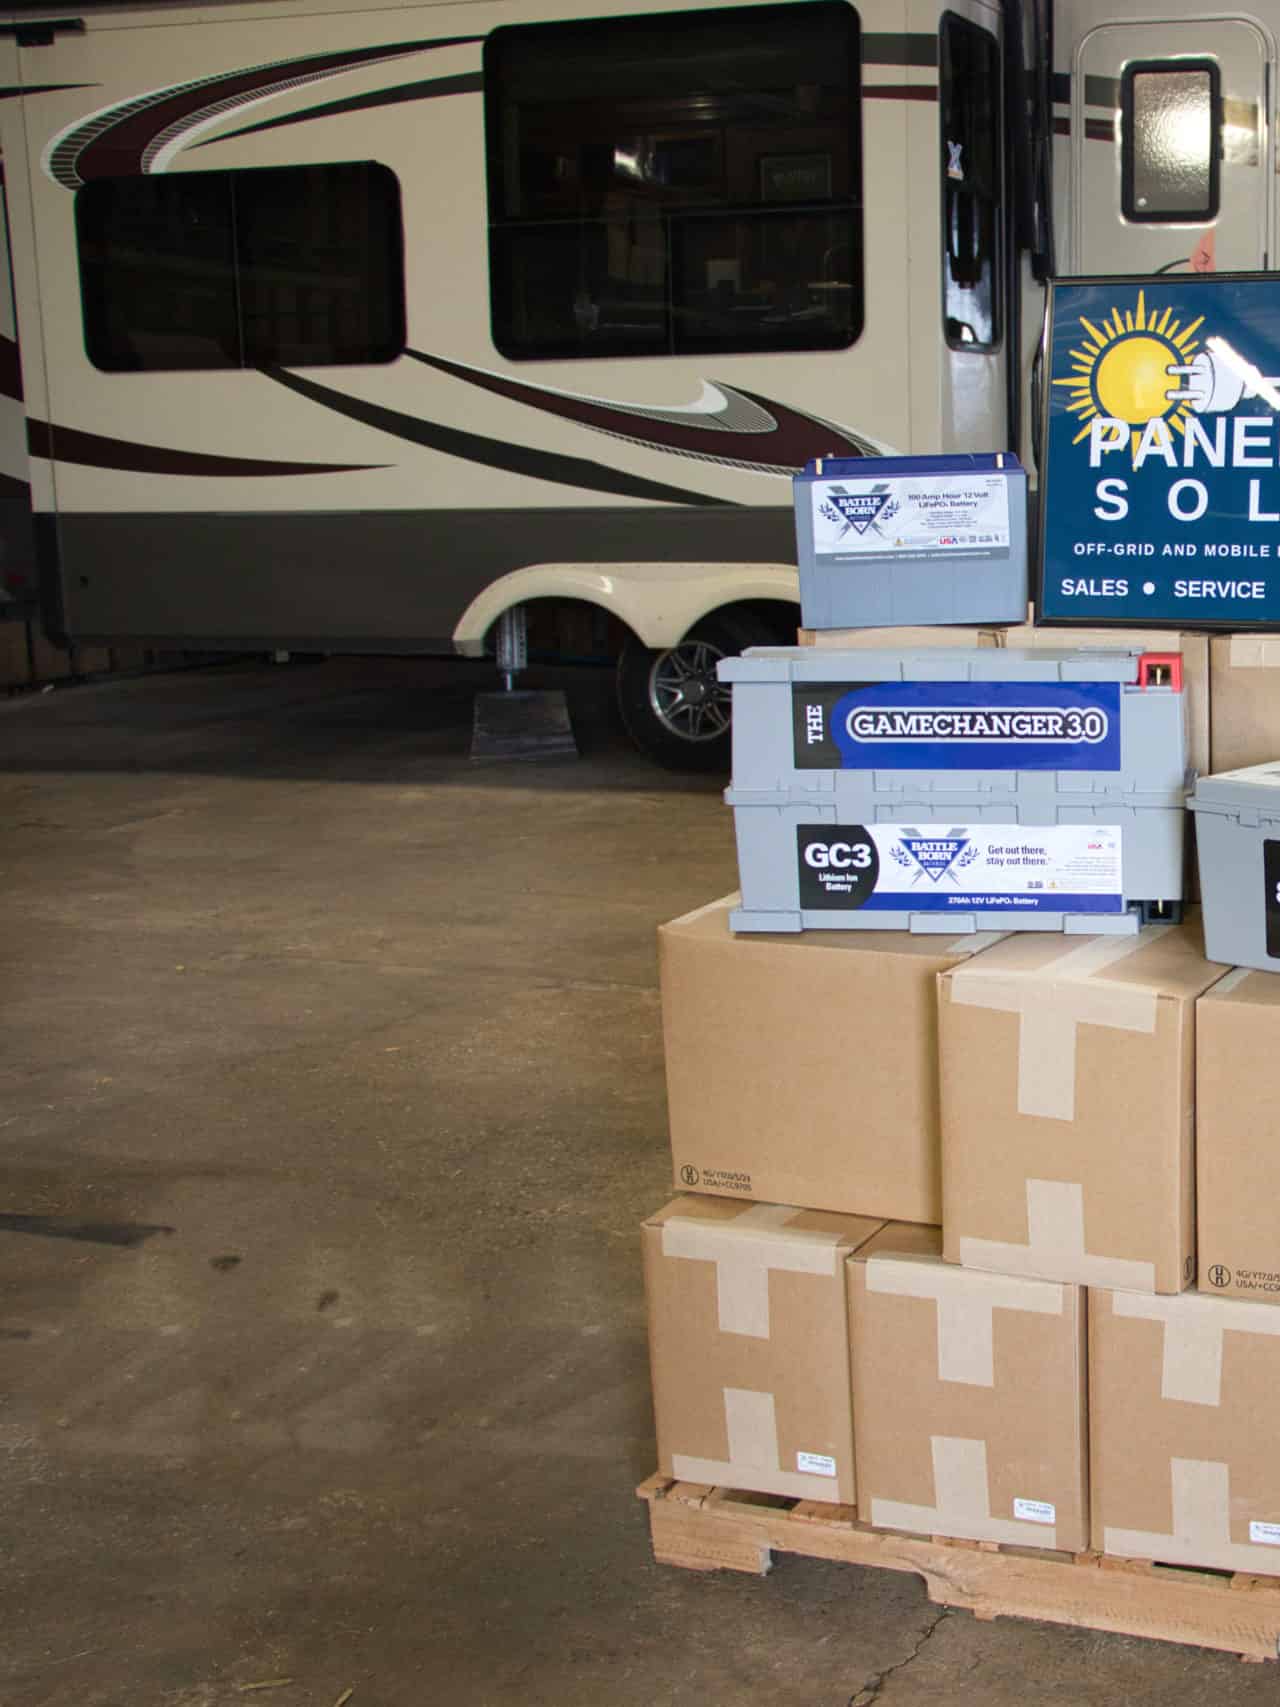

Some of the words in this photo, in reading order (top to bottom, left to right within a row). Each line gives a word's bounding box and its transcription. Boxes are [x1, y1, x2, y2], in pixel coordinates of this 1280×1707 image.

[838, 496, 881, 507] BATTLE
[1073, 542, 1155, 557] OFF-GRID
[1161, 543, 1198, 558] AND
[1203, 544, 1271, 558] MOBILE
[1060, 578, 1130, 597] SALES
[1173, 581, 1266, 599] SERVICE
[805, 704, 824, 745] THE
[852, 713, 1064, 738] GAMECHANGER
[1066, 711, 1102, 738] 3.0
[911, 842, 958, 851] BATTLE
[988, 844, 1003, 855] Get
[1005, 845, 1019, 855] out
[804, 842, 873, 868] GC3
[918, 852, 952, 860] BORN
[986, 857, 1004, 867] stay
[1006, 857, 1020, 866] out
[1013, 897, 1040, 908] Battery
